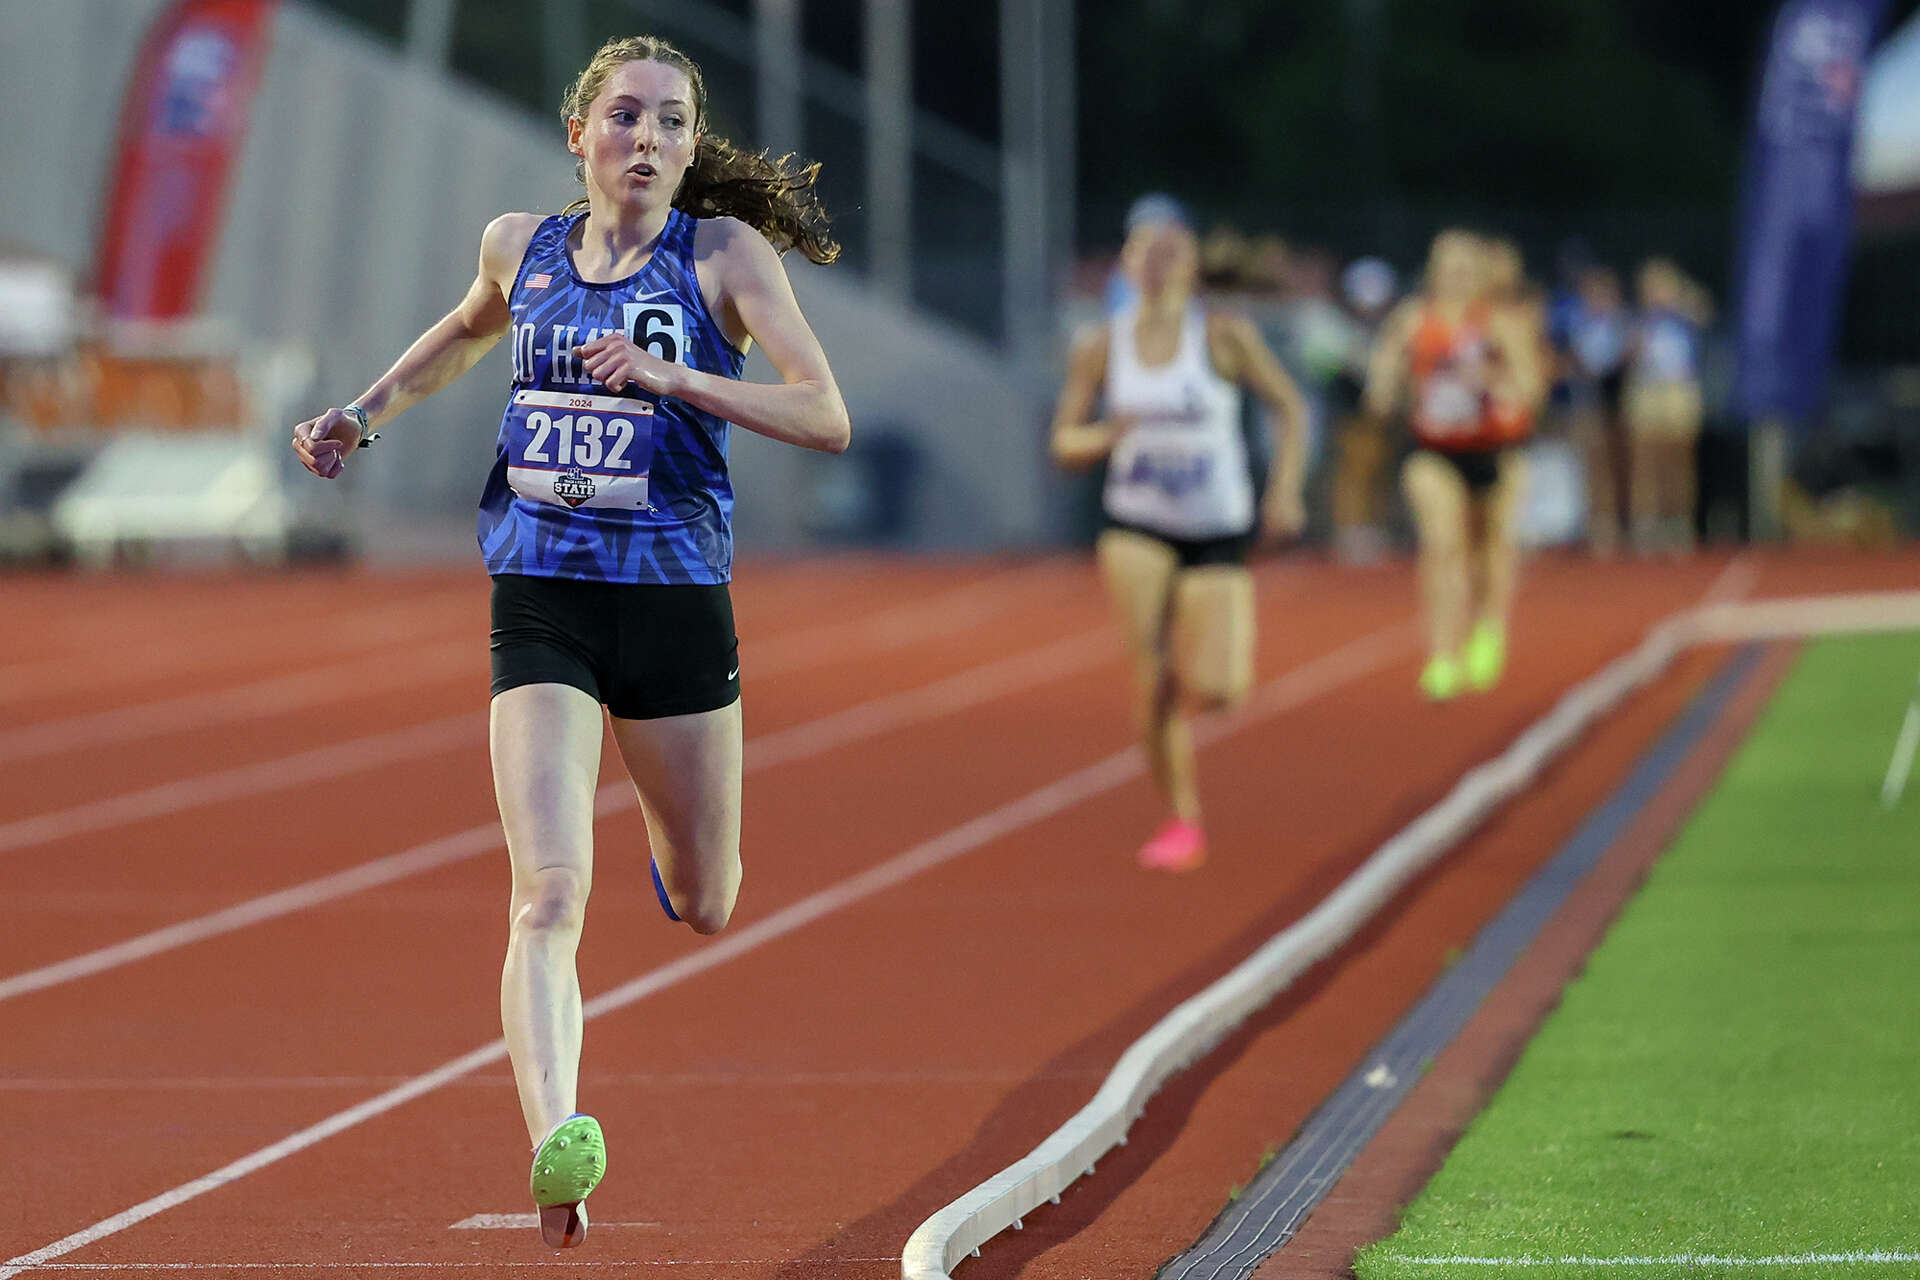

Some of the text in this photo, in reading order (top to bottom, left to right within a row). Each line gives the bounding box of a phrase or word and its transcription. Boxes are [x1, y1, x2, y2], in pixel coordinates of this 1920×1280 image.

[633, 308, 677, 364] 6
[568, 398, 592, 408] 2024
[523, 411, 634, 470] 2132
[554, 482, 595, 495] STATE
